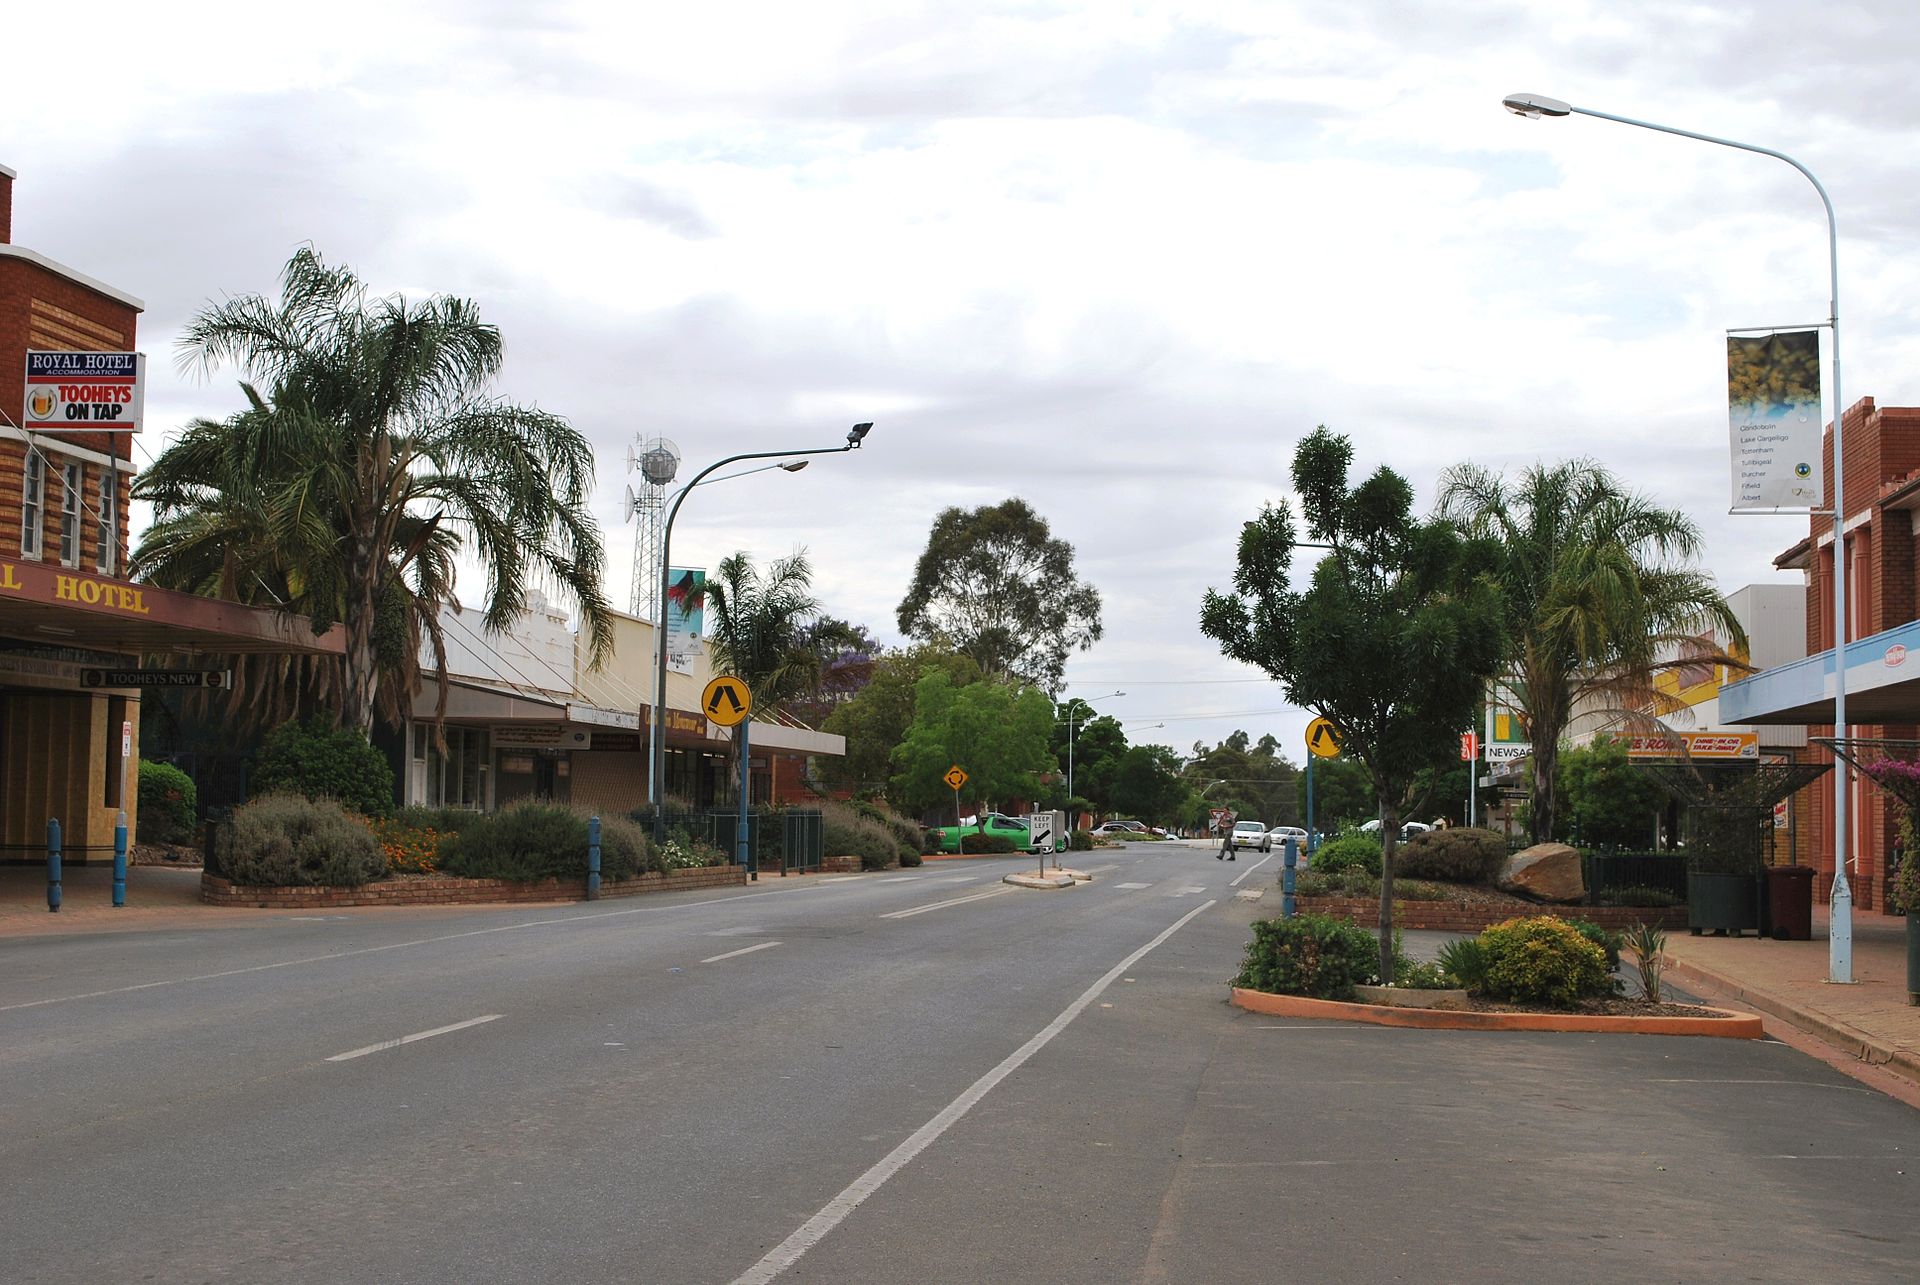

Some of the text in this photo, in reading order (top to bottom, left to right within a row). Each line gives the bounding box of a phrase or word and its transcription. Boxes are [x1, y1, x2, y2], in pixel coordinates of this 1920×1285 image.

[32, 354, 133, 369] ROYAL HOTEL
[58, 385, 132, 403] TOOHEYS
[65, 403, 123, 420] ON TAP
[56, 575, 150, 614] HOTEL
[111, 672, 197, 685] TOOHEYS NEW
